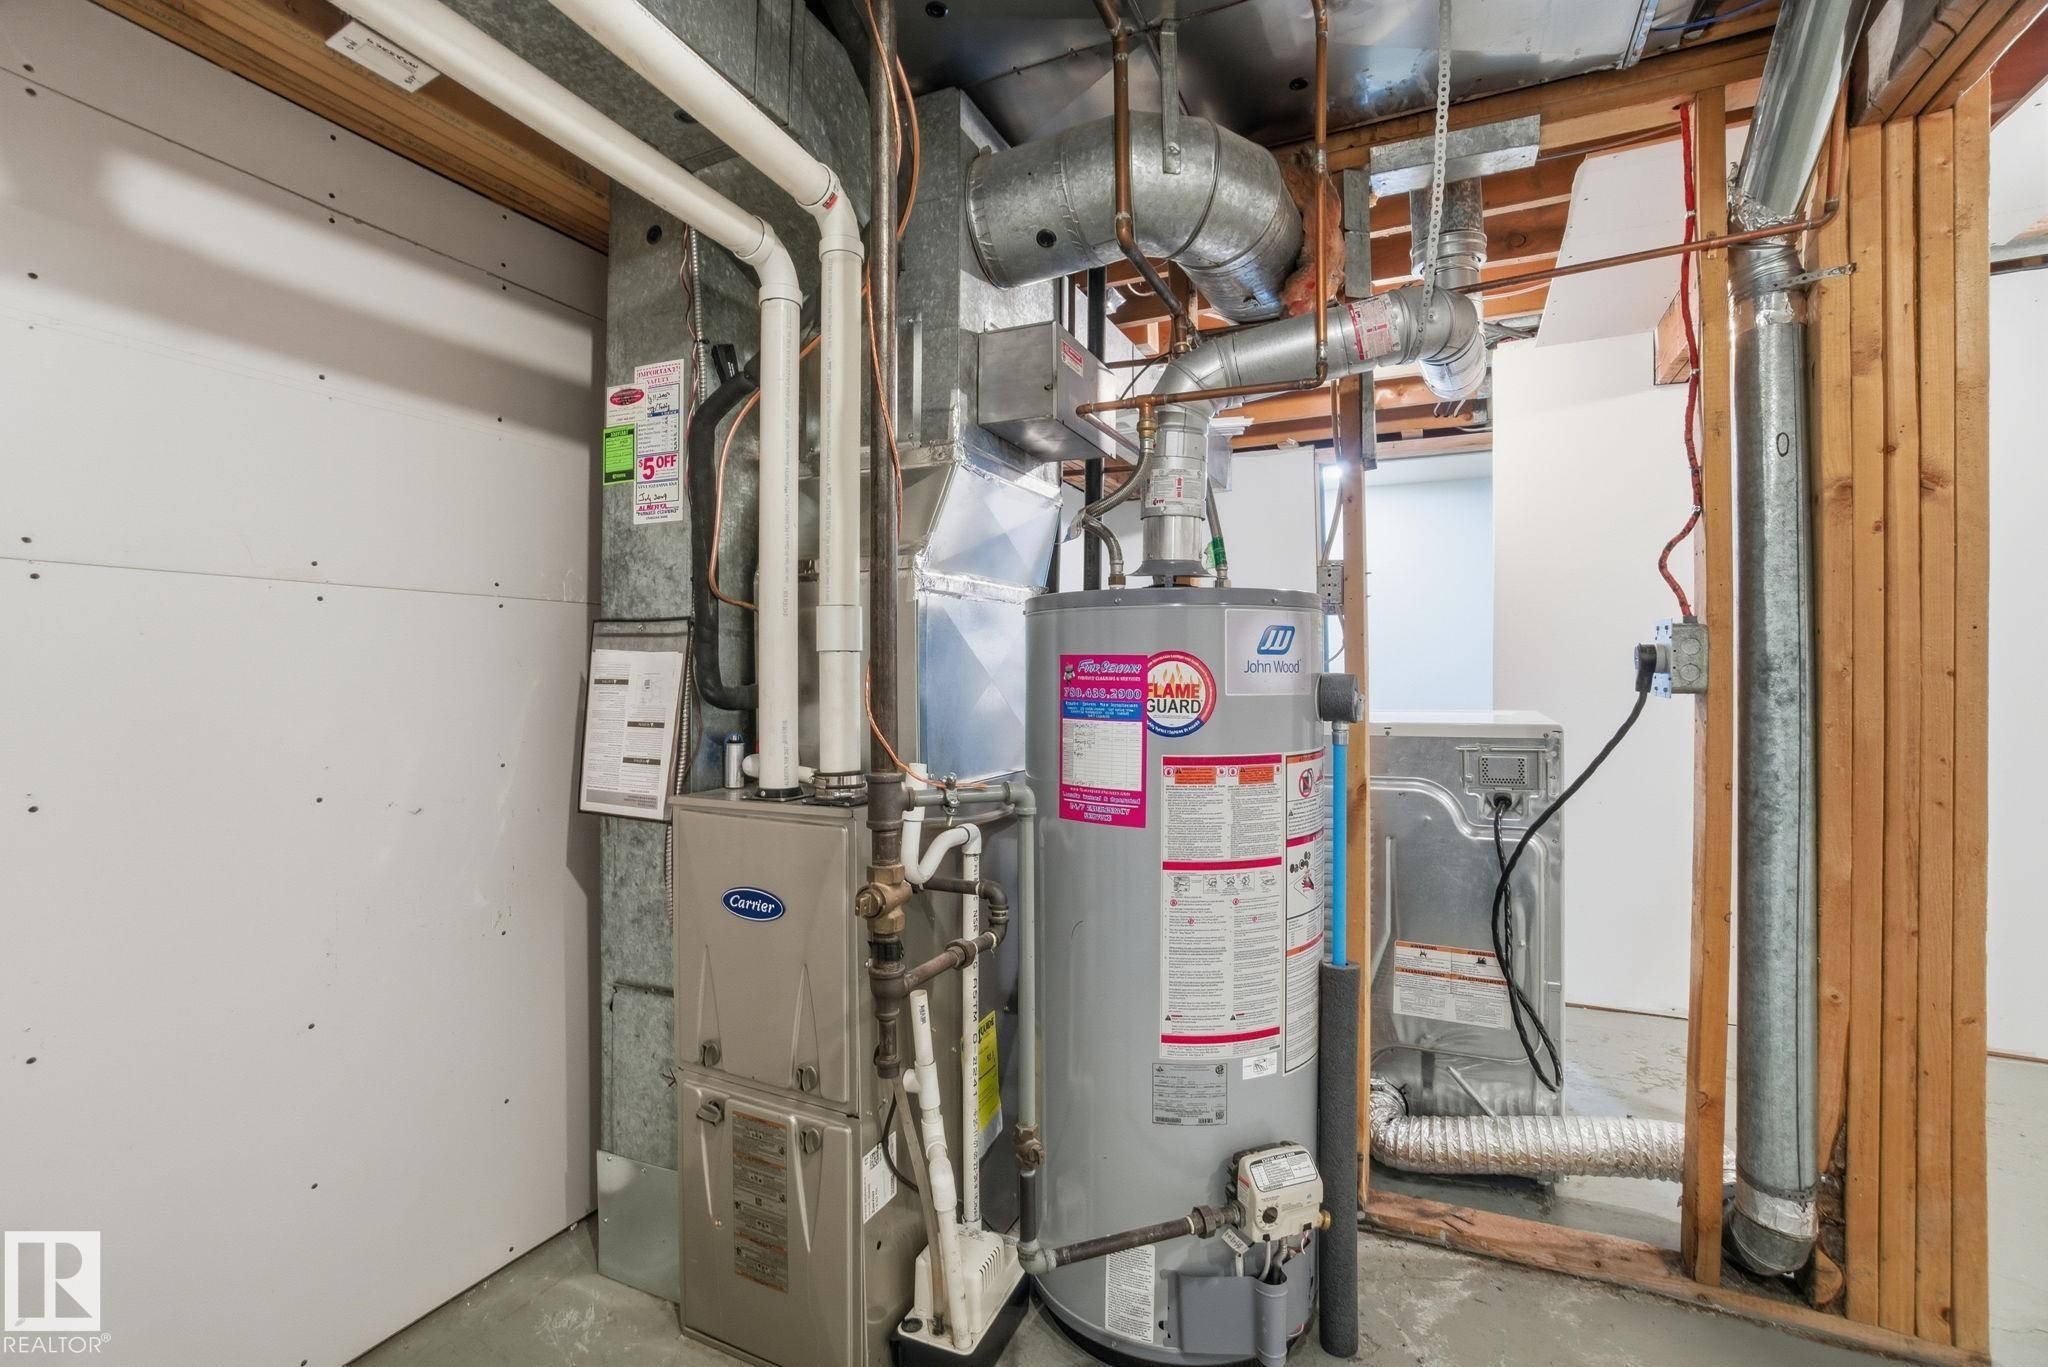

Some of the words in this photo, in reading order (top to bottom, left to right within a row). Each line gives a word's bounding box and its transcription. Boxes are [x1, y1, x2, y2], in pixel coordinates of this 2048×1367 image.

[656, 454, 678, 468] OFF
[1244, 660, 1271, 674] John
[1273, 660, 1300, 674] Wood
[1147, 682, 1200, 699] FLAME
[1147, 698, 1201, 714] GUARD
[729, 894, 775, 914] Carrier
